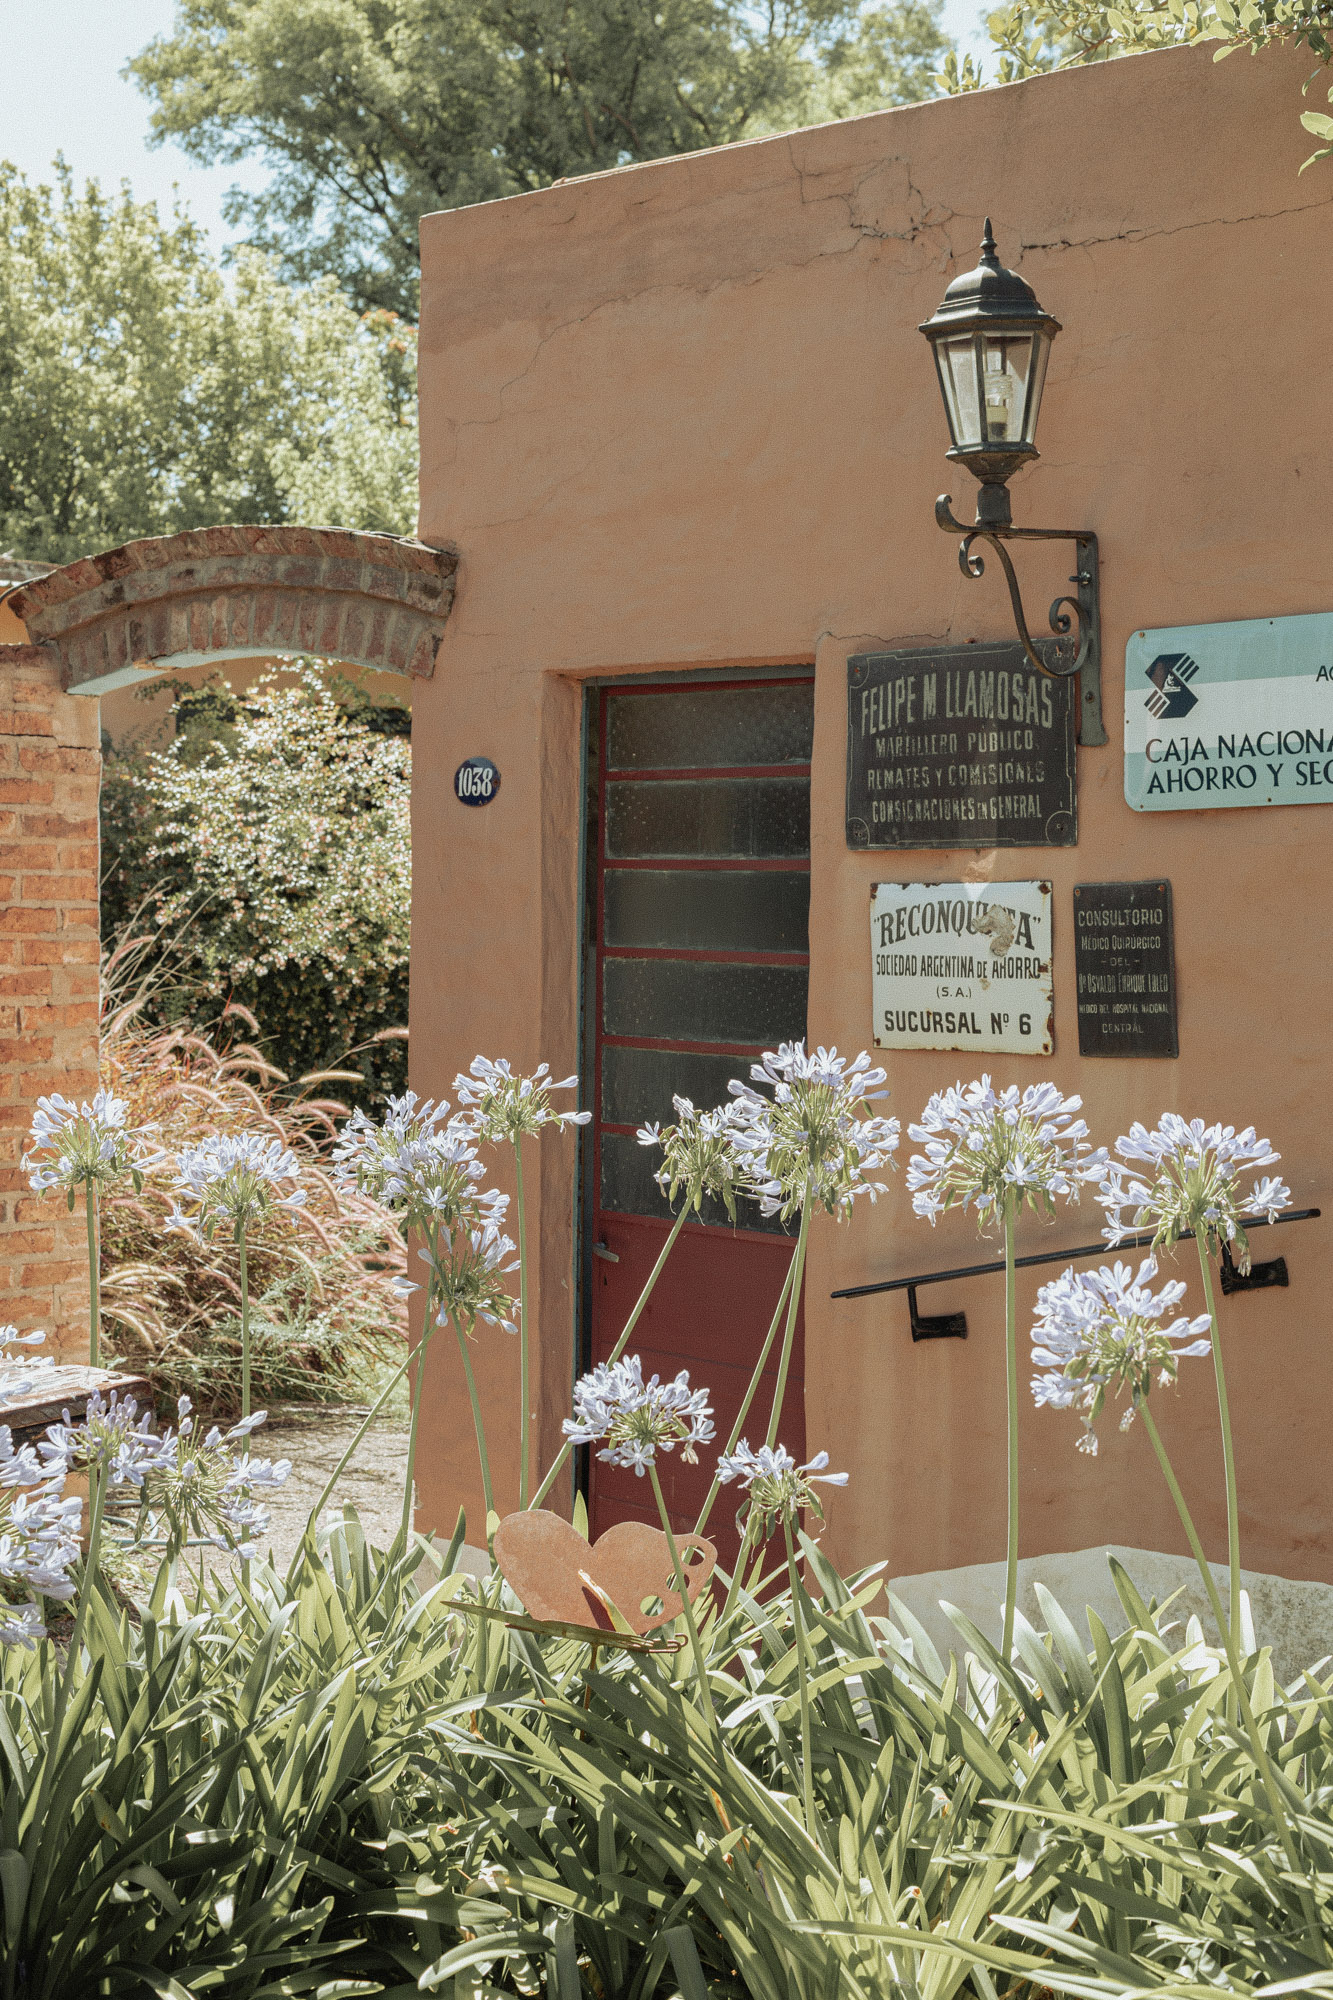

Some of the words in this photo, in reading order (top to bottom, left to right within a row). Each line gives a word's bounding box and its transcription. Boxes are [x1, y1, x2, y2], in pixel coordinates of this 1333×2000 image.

[1316, 664, 1333, 682] A
[861, 675, 916, 737] FELIPE
[923, 672, 937, 721] M
[945, 670, 1053, 729] LLAMOSAS
[875, 733, 957, 758] MARTILLERO
[967, 729, 1033, 753] PUBLICO
[1145, 737, 1209, 765] CAJA
[458, 767, 493, 797] 1038
[935, 767, 943, 787] Y
[949, 760, 1045, 786] COMISIONES
[1146, 764, 1257, 794] AHORRO
[1266, 762, 1284, 787] Y
[872, 797, 975, 823] CONSIGNACIONES
[977, 801, 988, 820] EN
[989, 794, 1042, 820] GENERAL
[1077, 908, 1163, 926] CONSULTORIO
[876, 954, 917, 977] SOCIEDAD
[920, 955, 975, 979] ARGENTINA
[976, 961, 988, 979] DE
[992, 957, 1041, 979] AHORRO
[884, 1010, 982, 1035] SUCURSAL
[1019, 1013, 1032, 1036] 6
[1102, 1022, 1144, 1034] CENTRAL
